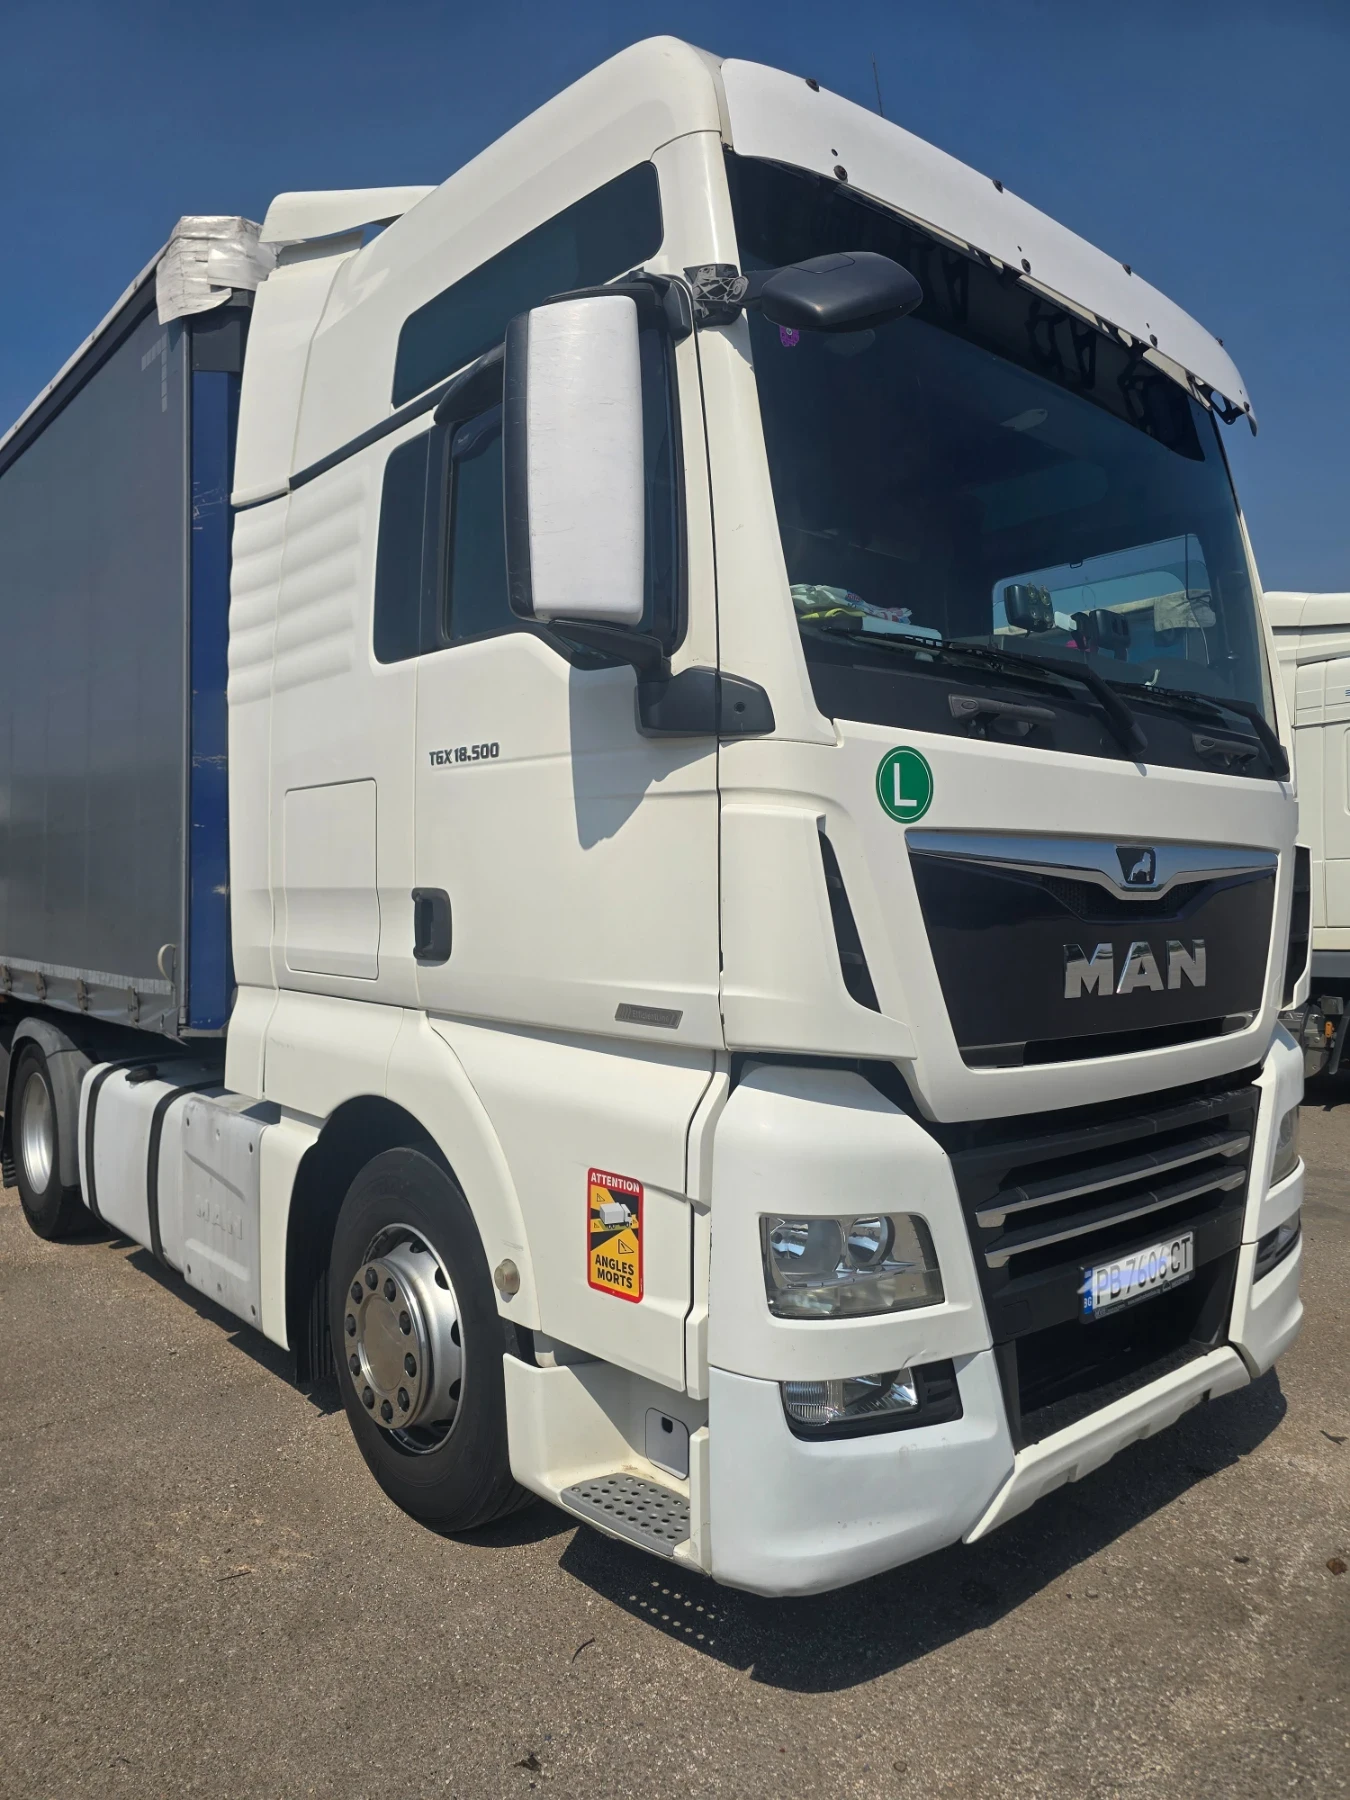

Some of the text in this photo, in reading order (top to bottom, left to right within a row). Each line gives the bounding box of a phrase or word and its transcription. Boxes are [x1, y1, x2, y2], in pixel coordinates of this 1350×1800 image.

[429, 742, 499, 766] TGX 18.500
[893, 762, 917, 807] L
[1063, 939, 1206, 999] MAN
[590, 1172, 640, 1193] ATTENTION
[595, 1254, 634, 1276] ANGLES
[597, 1267, 633, 1289] MORTS
